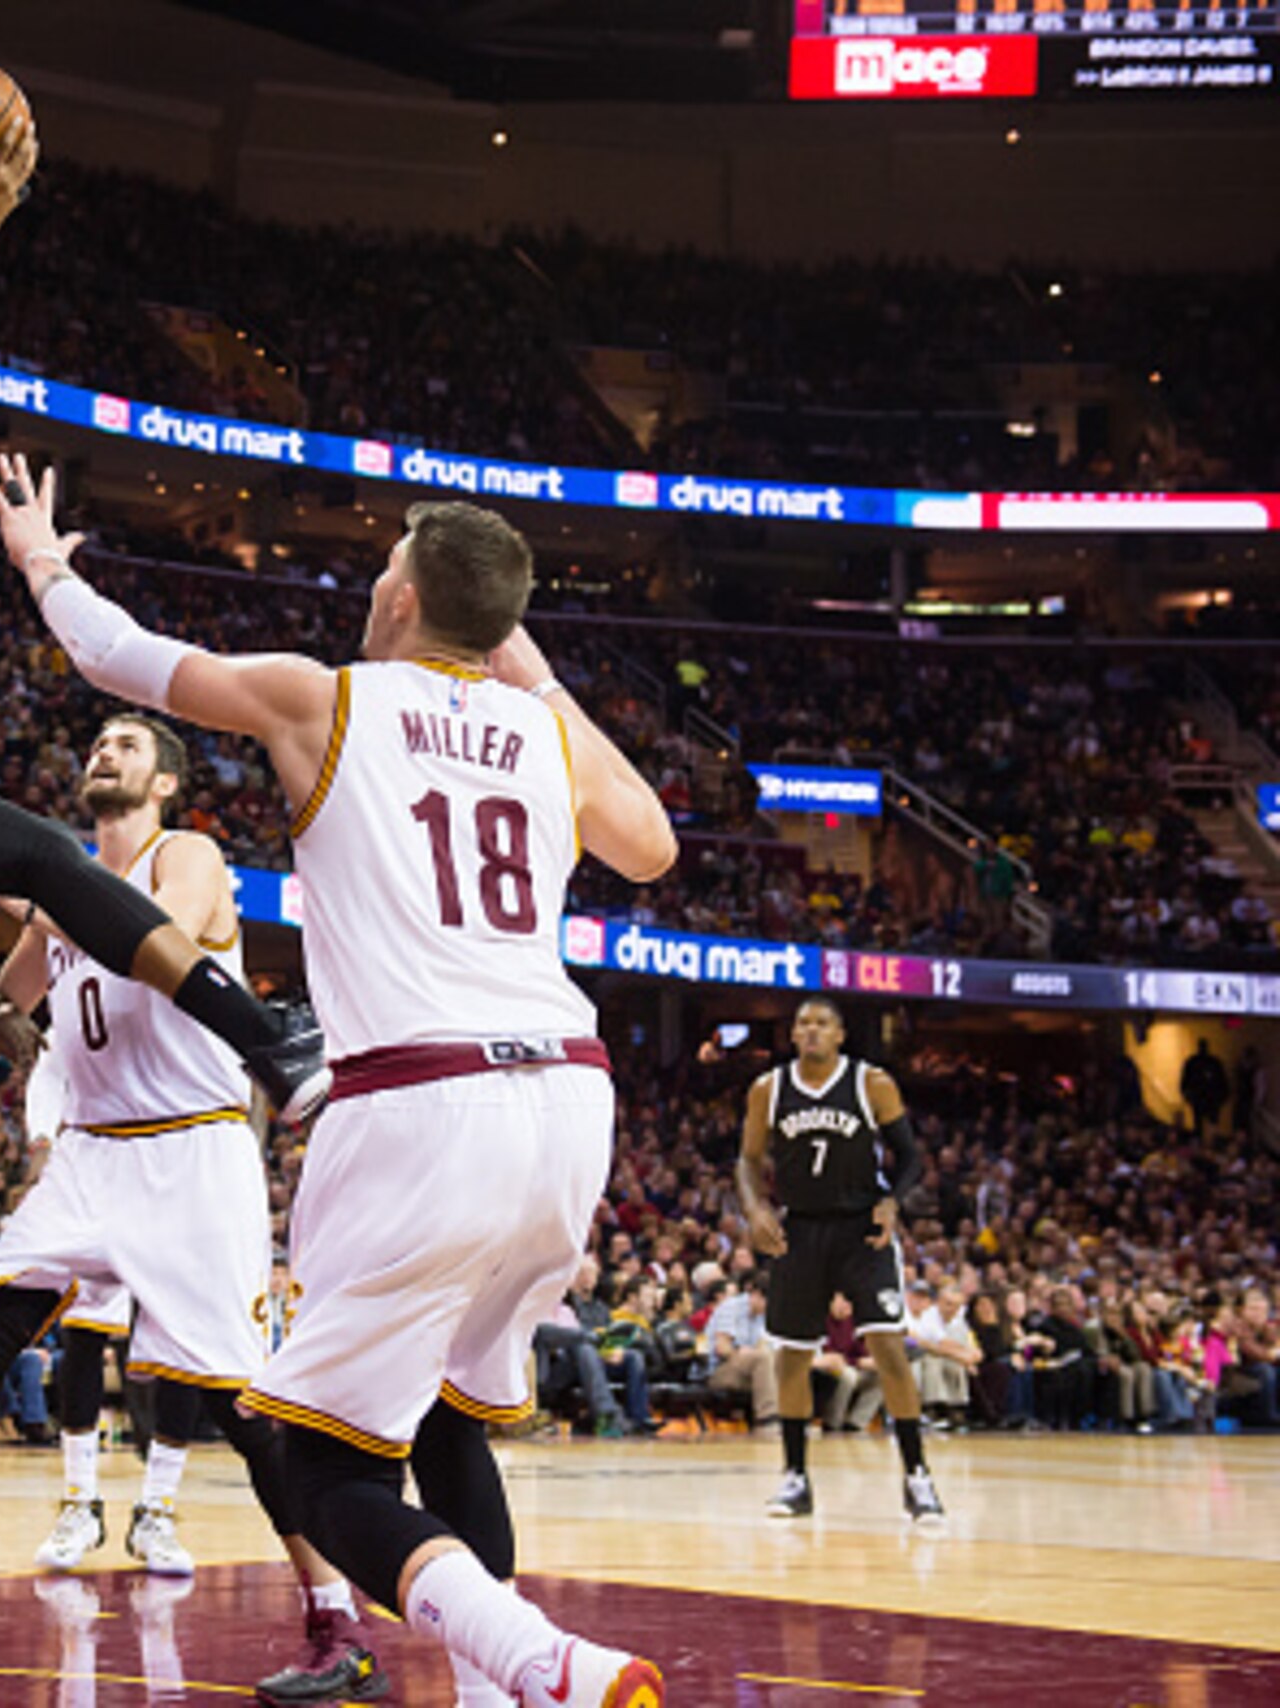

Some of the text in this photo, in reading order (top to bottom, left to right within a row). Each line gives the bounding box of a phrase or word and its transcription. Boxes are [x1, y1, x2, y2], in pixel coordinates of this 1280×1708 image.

[139, 405, 216, 454] drug
[222, 426, 306, 464] mart
[483, 466, 563, 499] mart
[759, 485, 844, 519] mart
[399, 708, 524, 775] MILLER
[408, 787, 538, 936] 18
[706, 944, 805, 987] mart
[858, 954, 901, 991] CLE
[931, 960, 962, 996] 12
[1124, 971, 1156, 1007] 14
[78, 974, 110, 1052] 0
[778, 1107, 861, 1139] BROOKLYN
[811, 1137, 828, 1177] 7
